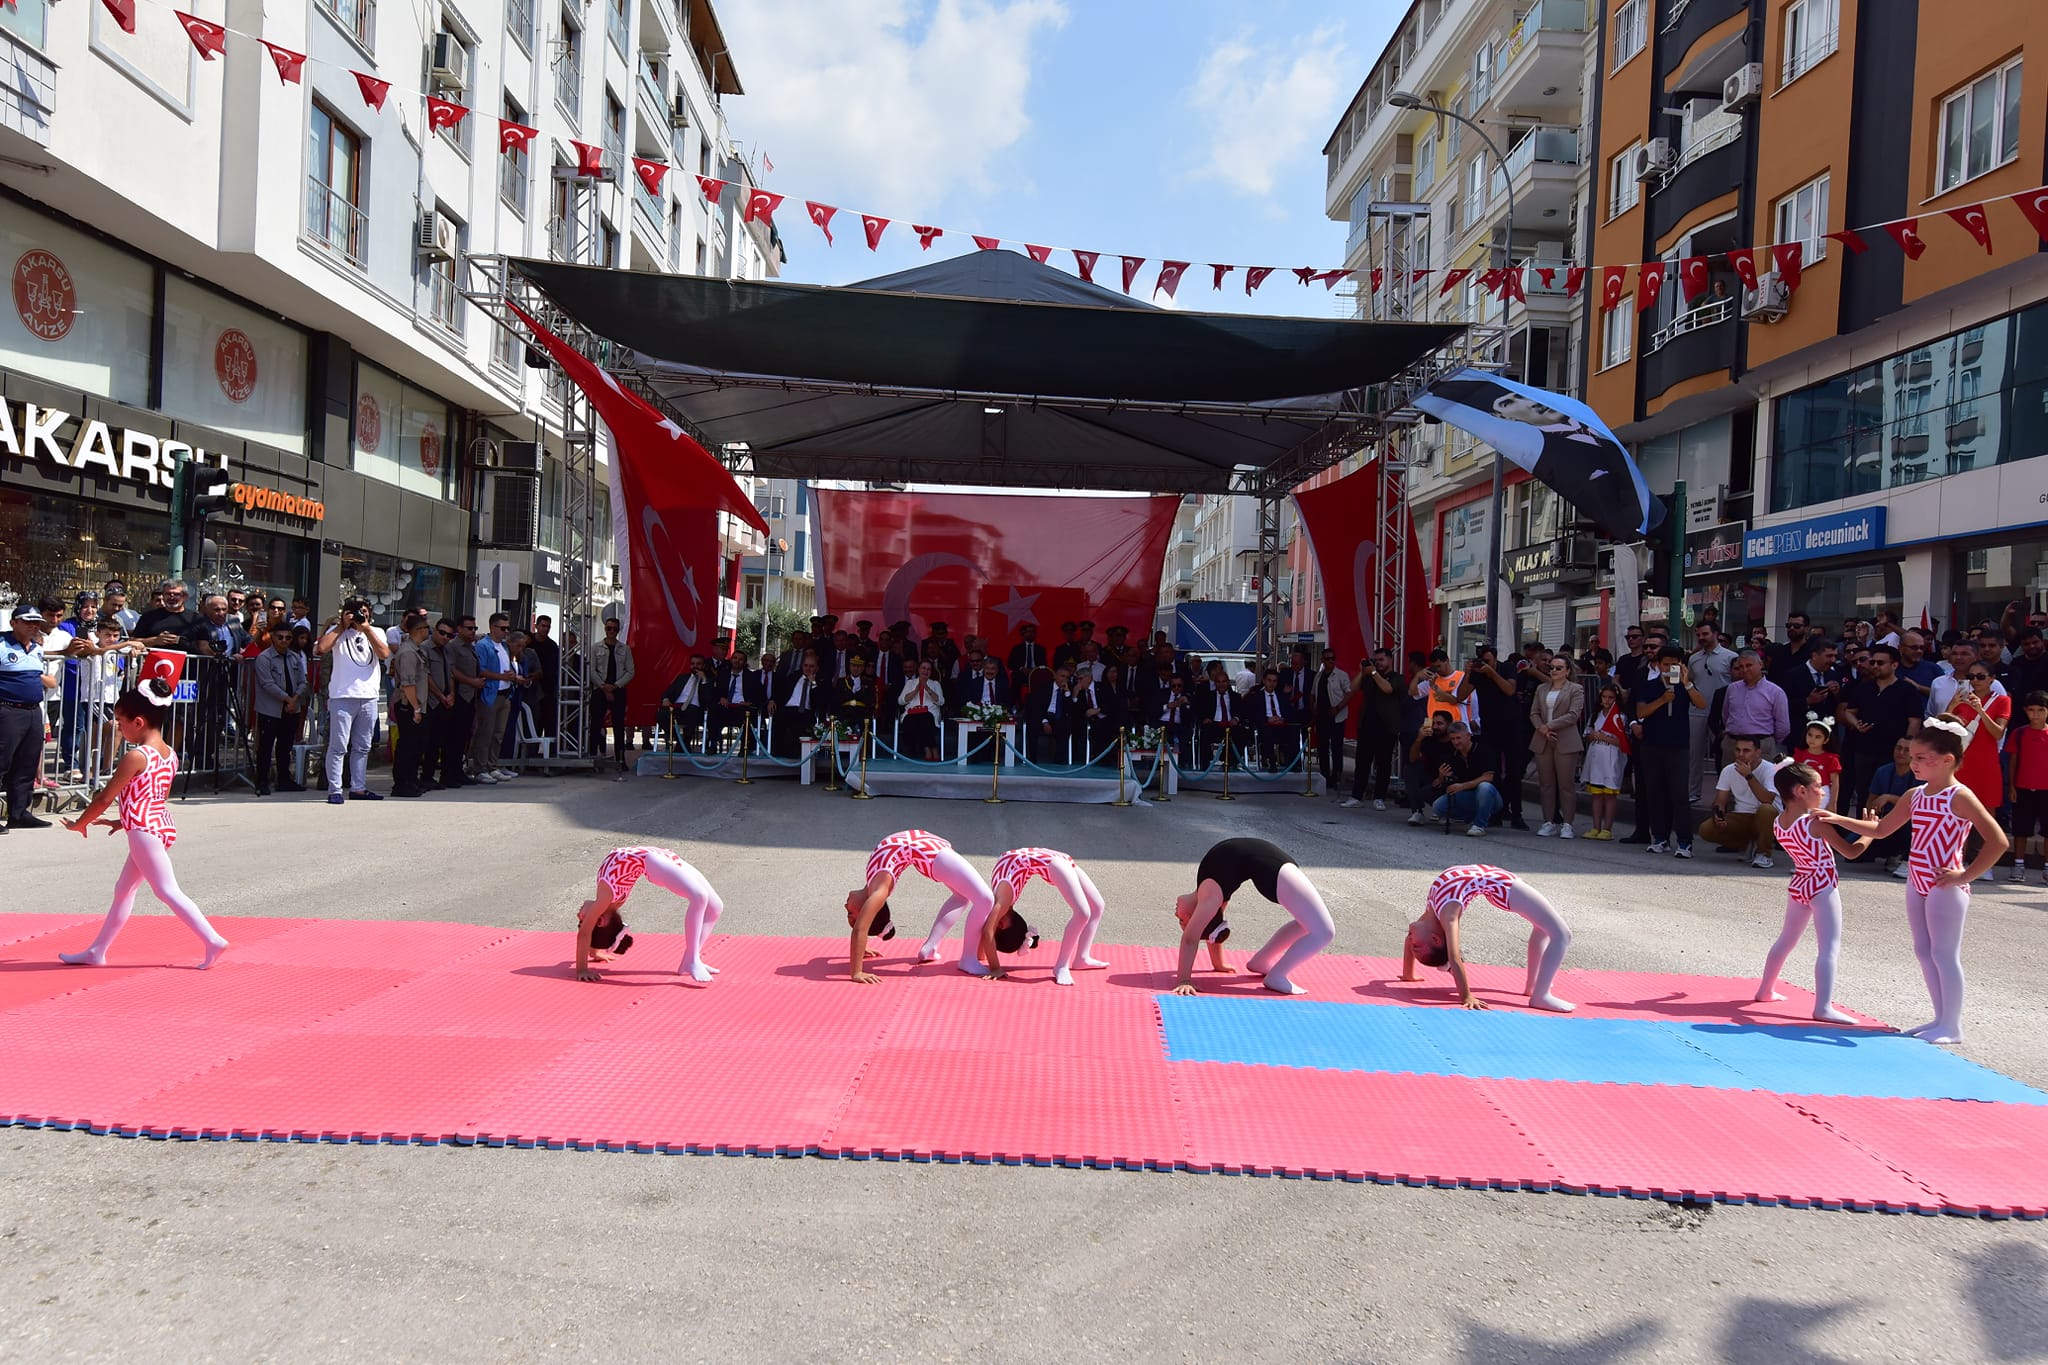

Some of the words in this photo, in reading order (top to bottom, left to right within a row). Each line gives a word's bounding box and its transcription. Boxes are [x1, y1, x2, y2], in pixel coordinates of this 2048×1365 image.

[21, 255, 71, 291] AKARSU
[220, 333, 254, 361] AKARSU
[1747, 530, 1801, 558] EGEPEN
[1805, 518, 1869, 549] deceuninck
[1515, 553, 1539, 573] KLAS
[1697, 541, 1740, 568] FUJITSU
